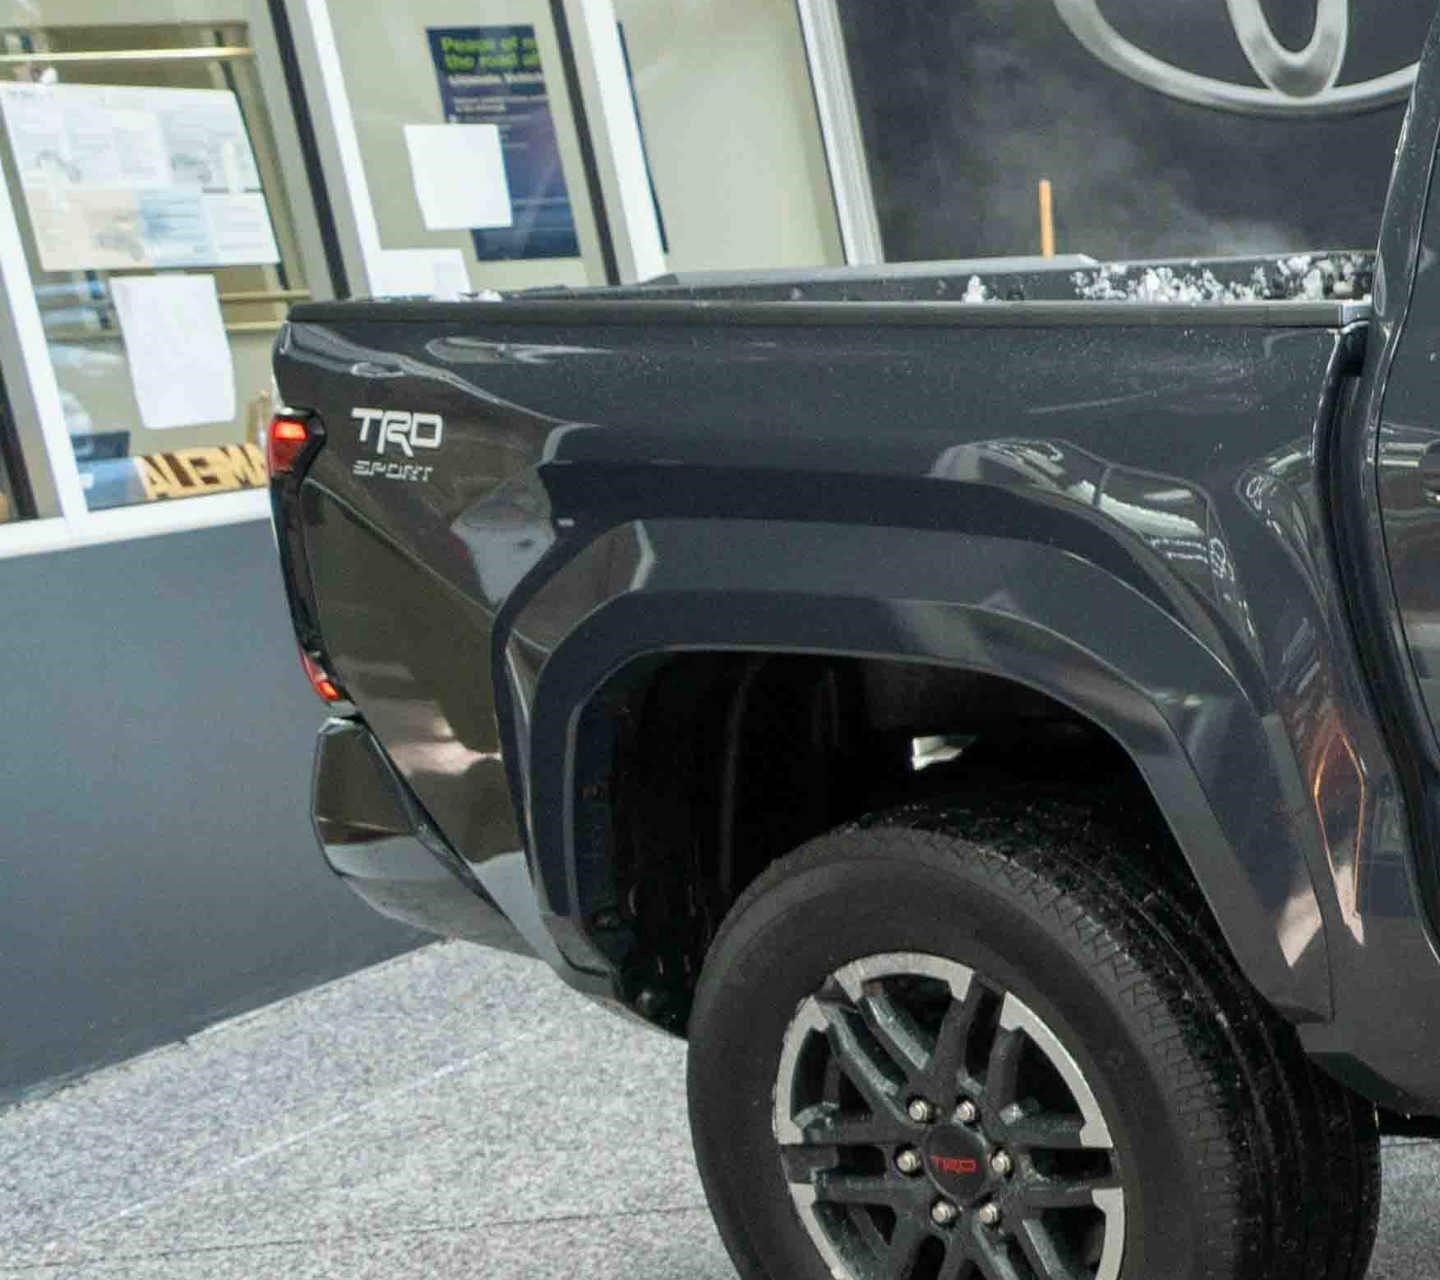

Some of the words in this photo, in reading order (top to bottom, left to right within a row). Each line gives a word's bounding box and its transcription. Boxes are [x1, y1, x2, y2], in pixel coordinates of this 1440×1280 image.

[445, 53, 476, 70] the
[352, 407, 444, 457] TRD
[352, 460, 434, 483] SPORT
